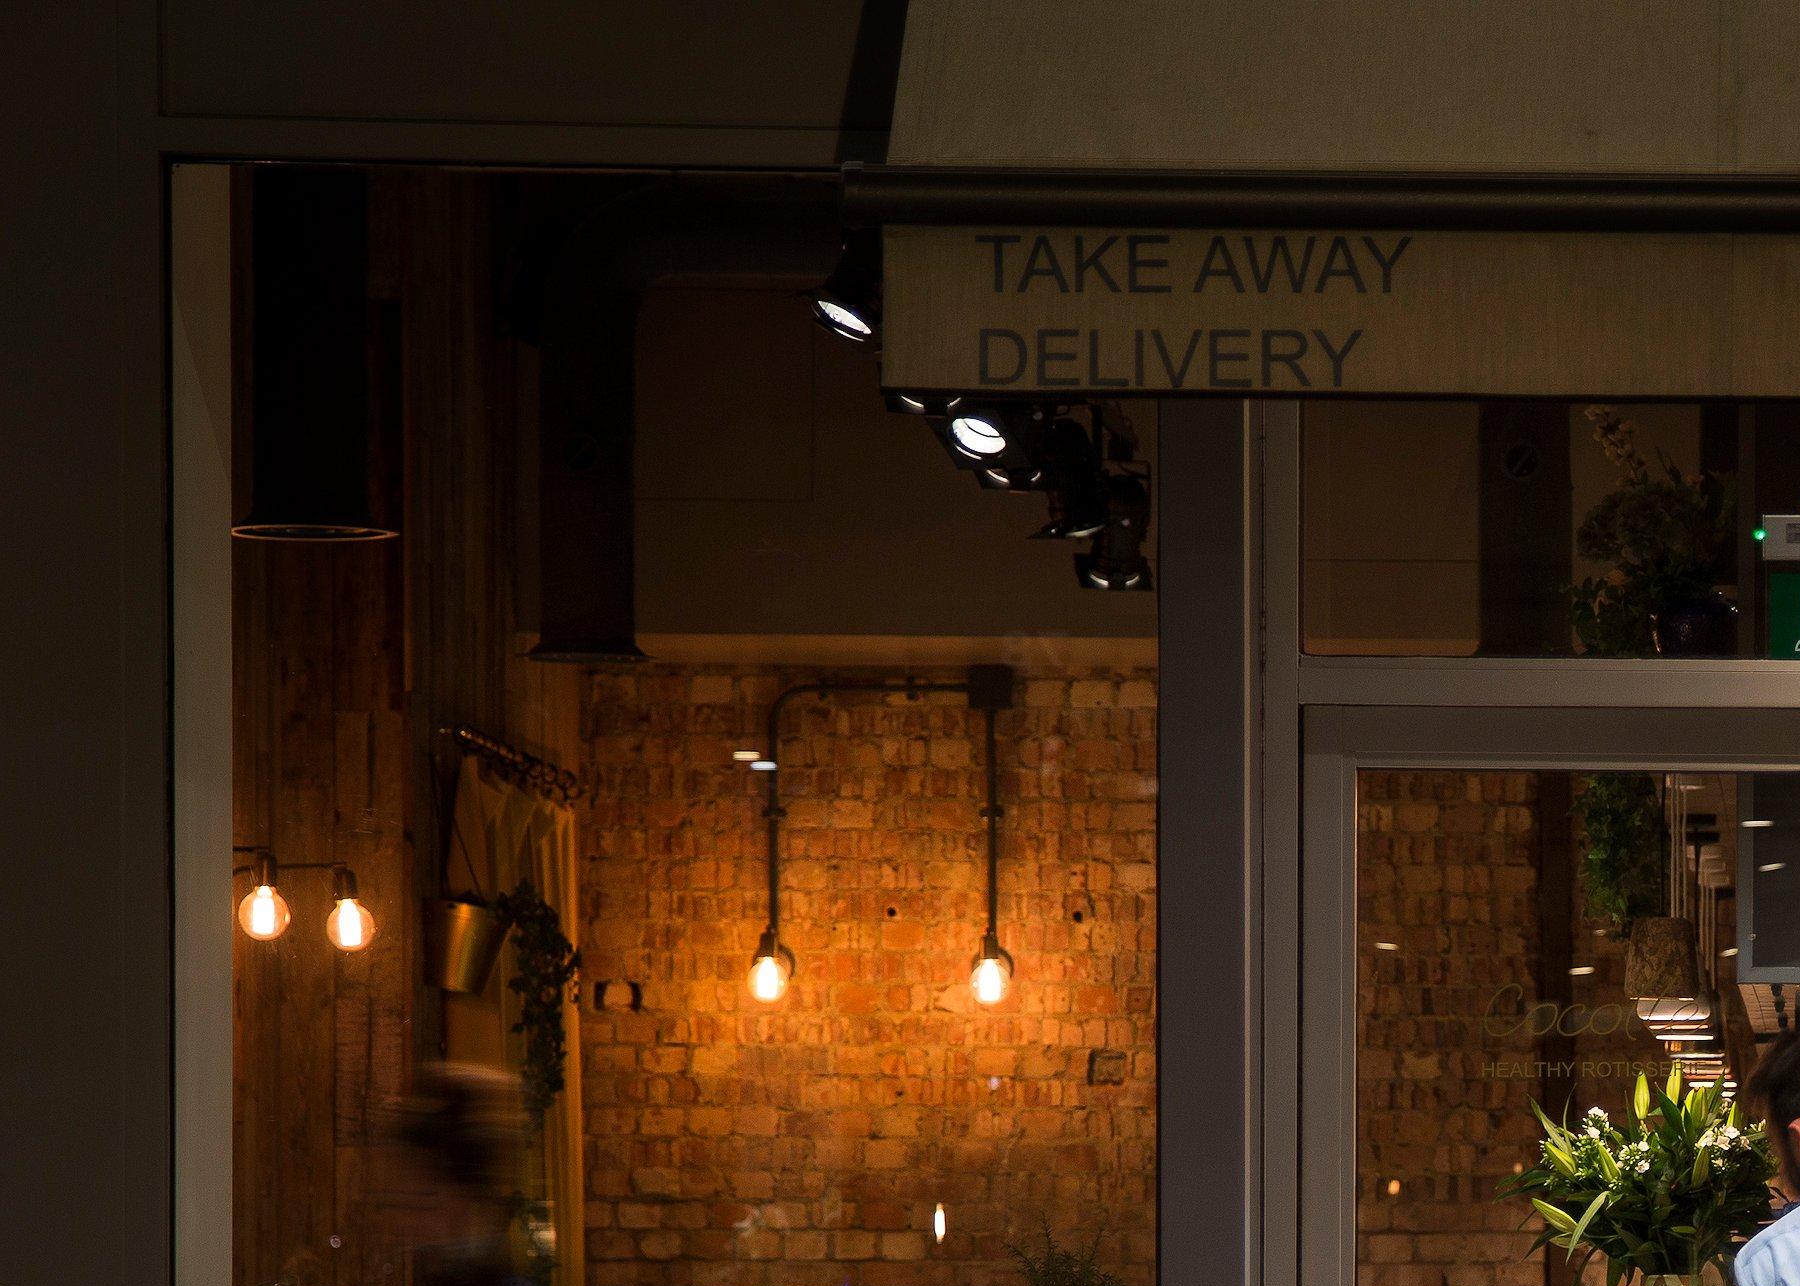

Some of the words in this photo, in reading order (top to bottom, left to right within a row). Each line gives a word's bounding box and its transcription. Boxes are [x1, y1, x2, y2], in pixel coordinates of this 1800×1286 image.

[975, 235, 1172, 294] TAKE
[1193, 235, 1412, 294] AWAY
[978, 328, 1365, 388] DELIVERY
[1481, 1061, 1576, 1078] HEALTHY
